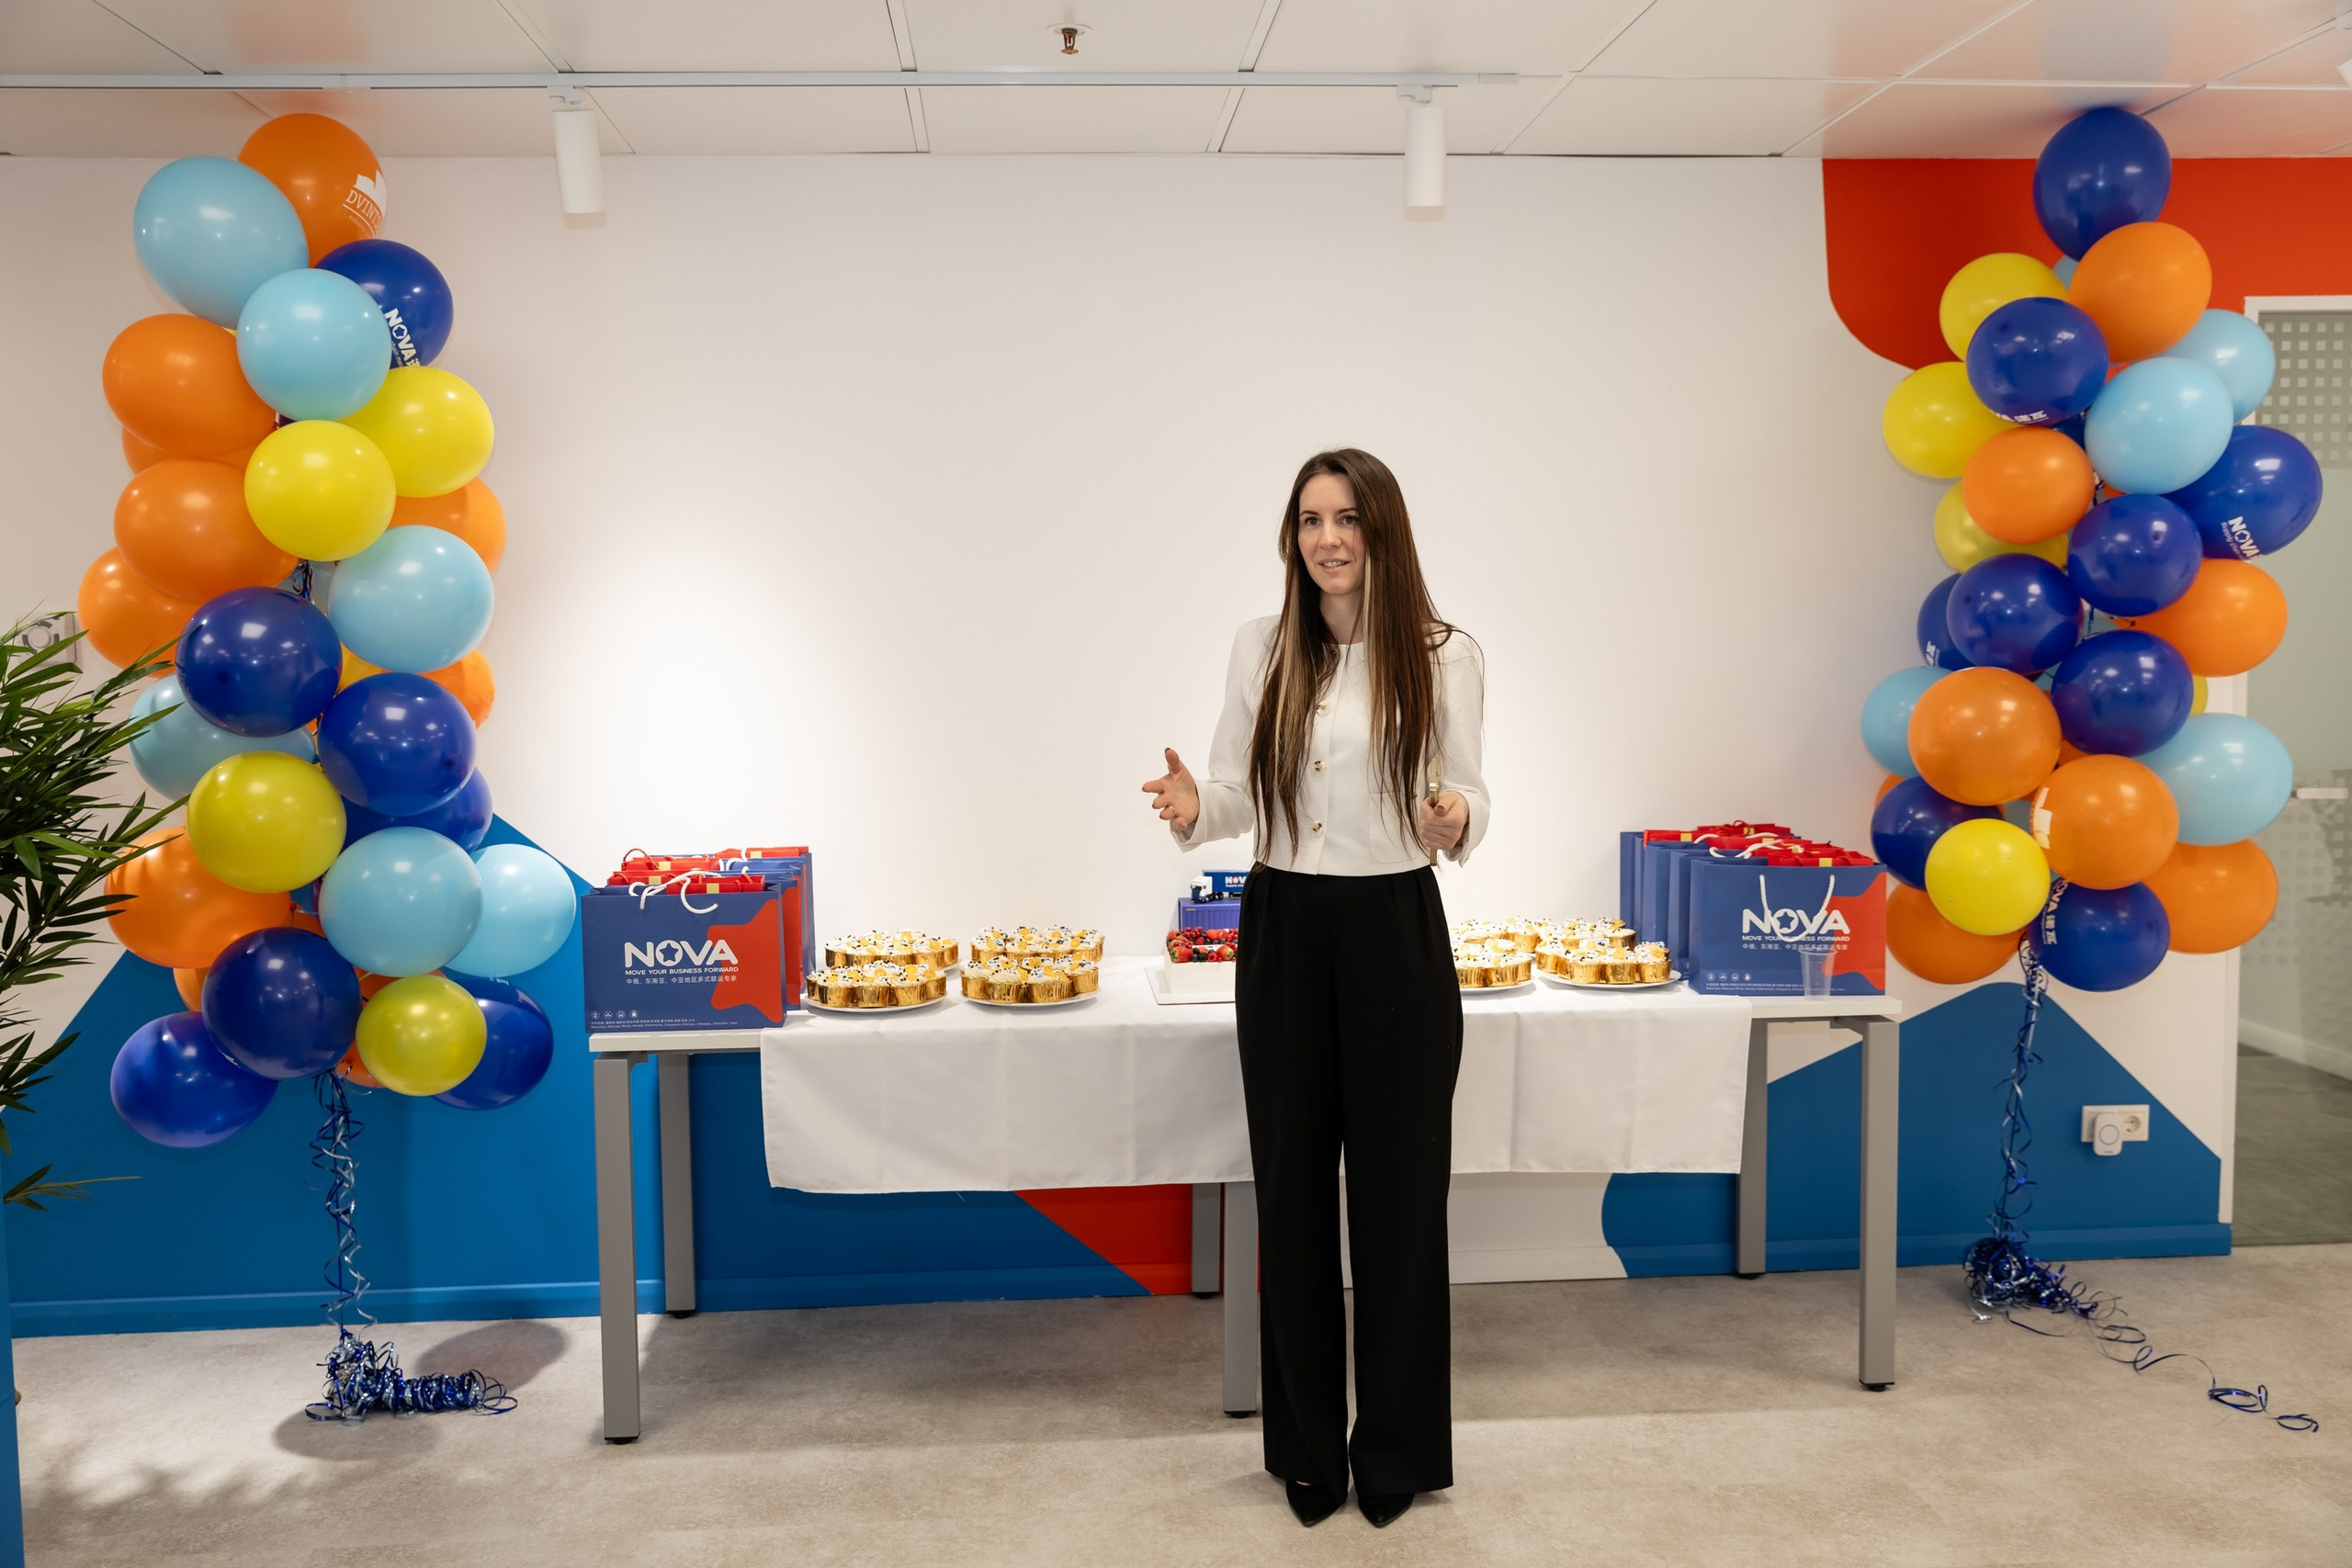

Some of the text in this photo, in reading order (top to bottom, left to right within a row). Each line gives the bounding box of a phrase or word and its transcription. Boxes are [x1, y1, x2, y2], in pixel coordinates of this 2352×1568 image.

[384, 308, 417, 362] NOVA
[2228, 515, 2259, 558] NOVA
[1742, 908, 1851, 934] NOVA
[624, 939, 739, 967] NOVA
